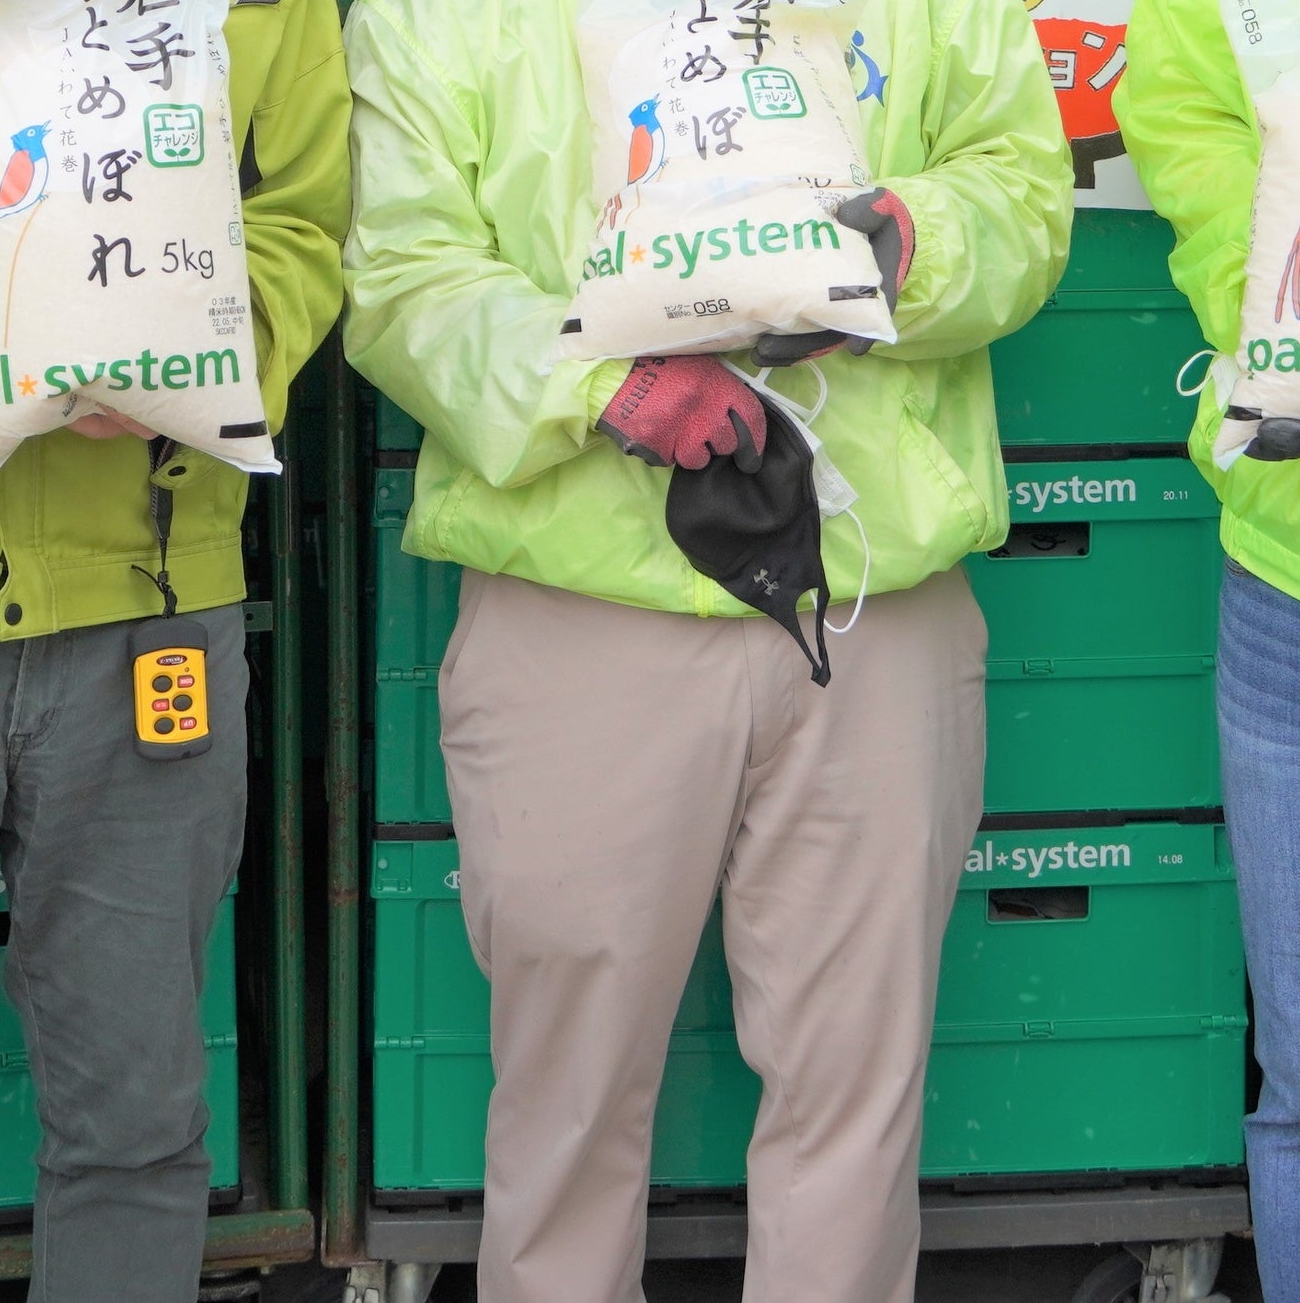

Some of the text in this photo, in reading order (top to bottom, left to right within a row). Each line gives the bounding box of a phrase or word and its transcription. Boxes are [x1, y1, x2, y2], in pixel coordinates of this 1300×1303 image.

[1240, 7, 1263, 46] 058
[752, 74, 793, 91] エコ
[753, 90, 797, 104] チャレンジ
[152, 112, 197, 133] エコ
[152, 134, 200, 151] チャレンジ
[160, 238, 215, 280] 5kg
[652, 217, 841, 279] system
[693, 298, 731, 315] 058
[1015, 474, 1189, 513] system 20.11
[1011, 842, 1132, 878] system
[1157, 853, 1183, 865] 14.08
